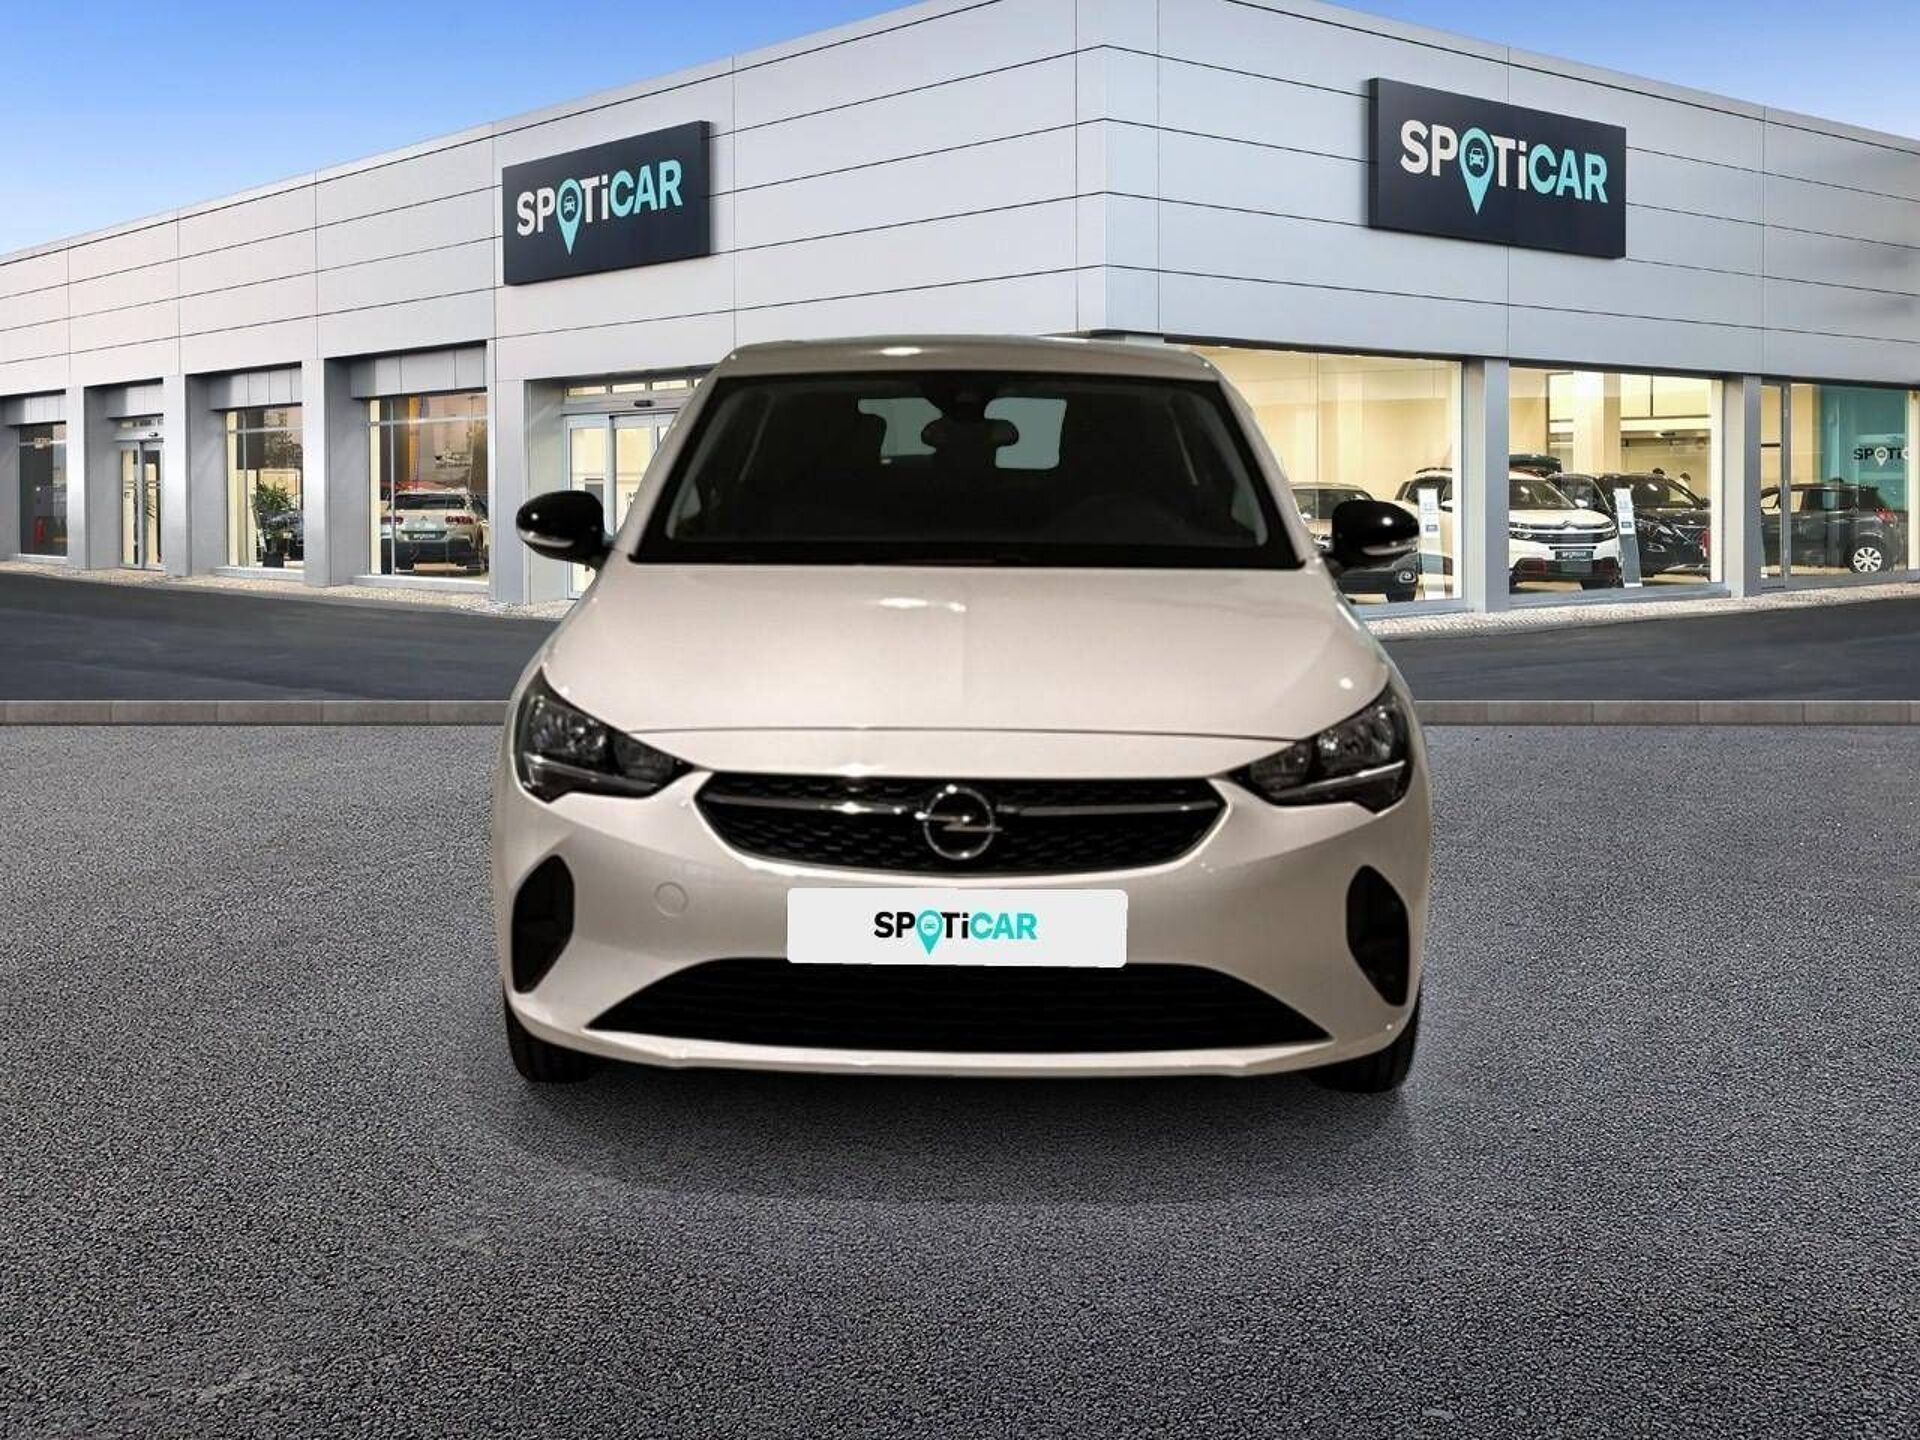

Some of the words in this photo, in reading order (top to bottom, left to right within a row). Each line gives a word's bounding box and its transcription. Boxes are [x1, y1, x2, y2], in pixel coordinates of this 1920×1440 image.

[516, 159, 683, 255] SPOTiCAR
[1400, 119, 1608, 215] SPOTiCAR
[873, 909, 1038, 955] SPOTiCAR
